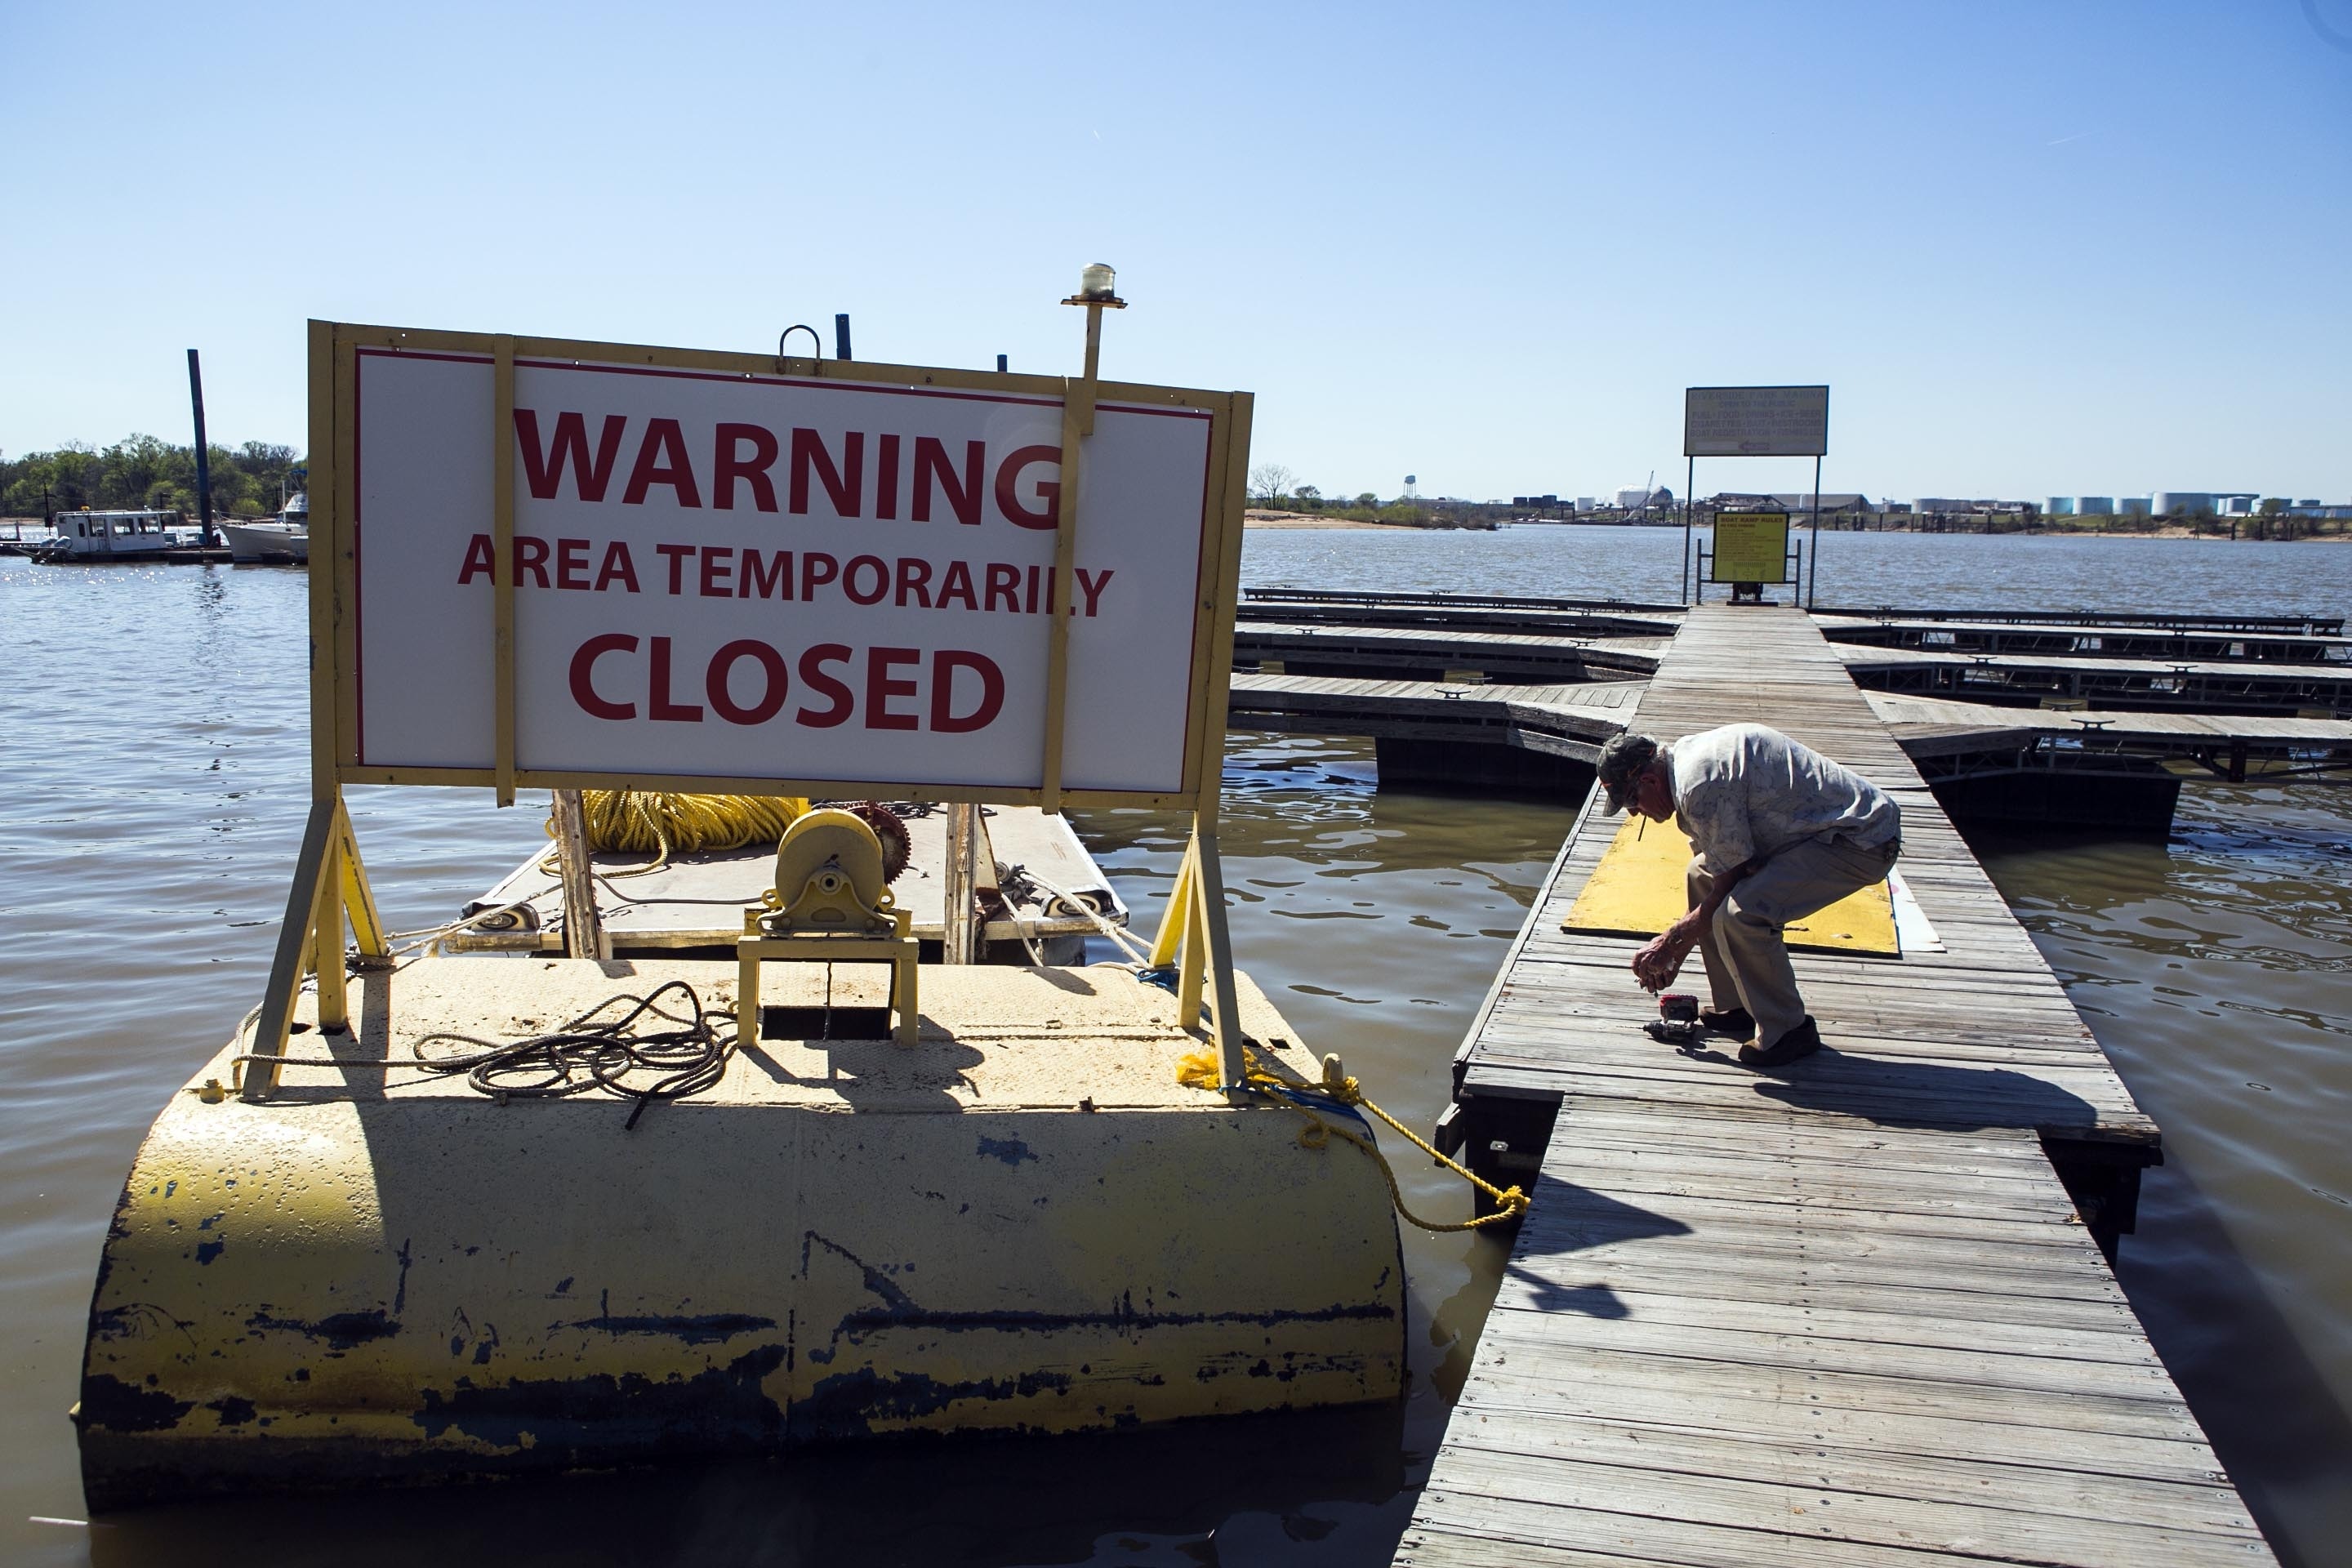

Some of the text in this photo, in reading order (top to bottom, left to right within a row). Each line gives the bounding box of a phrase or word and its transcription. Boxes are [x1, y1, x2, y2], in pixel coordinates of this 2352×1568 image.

[513, 408, 1063, 531] WARNING
[457, 533, 641, 593] AREA
[569, 633, 1005, 733] CLOSED
